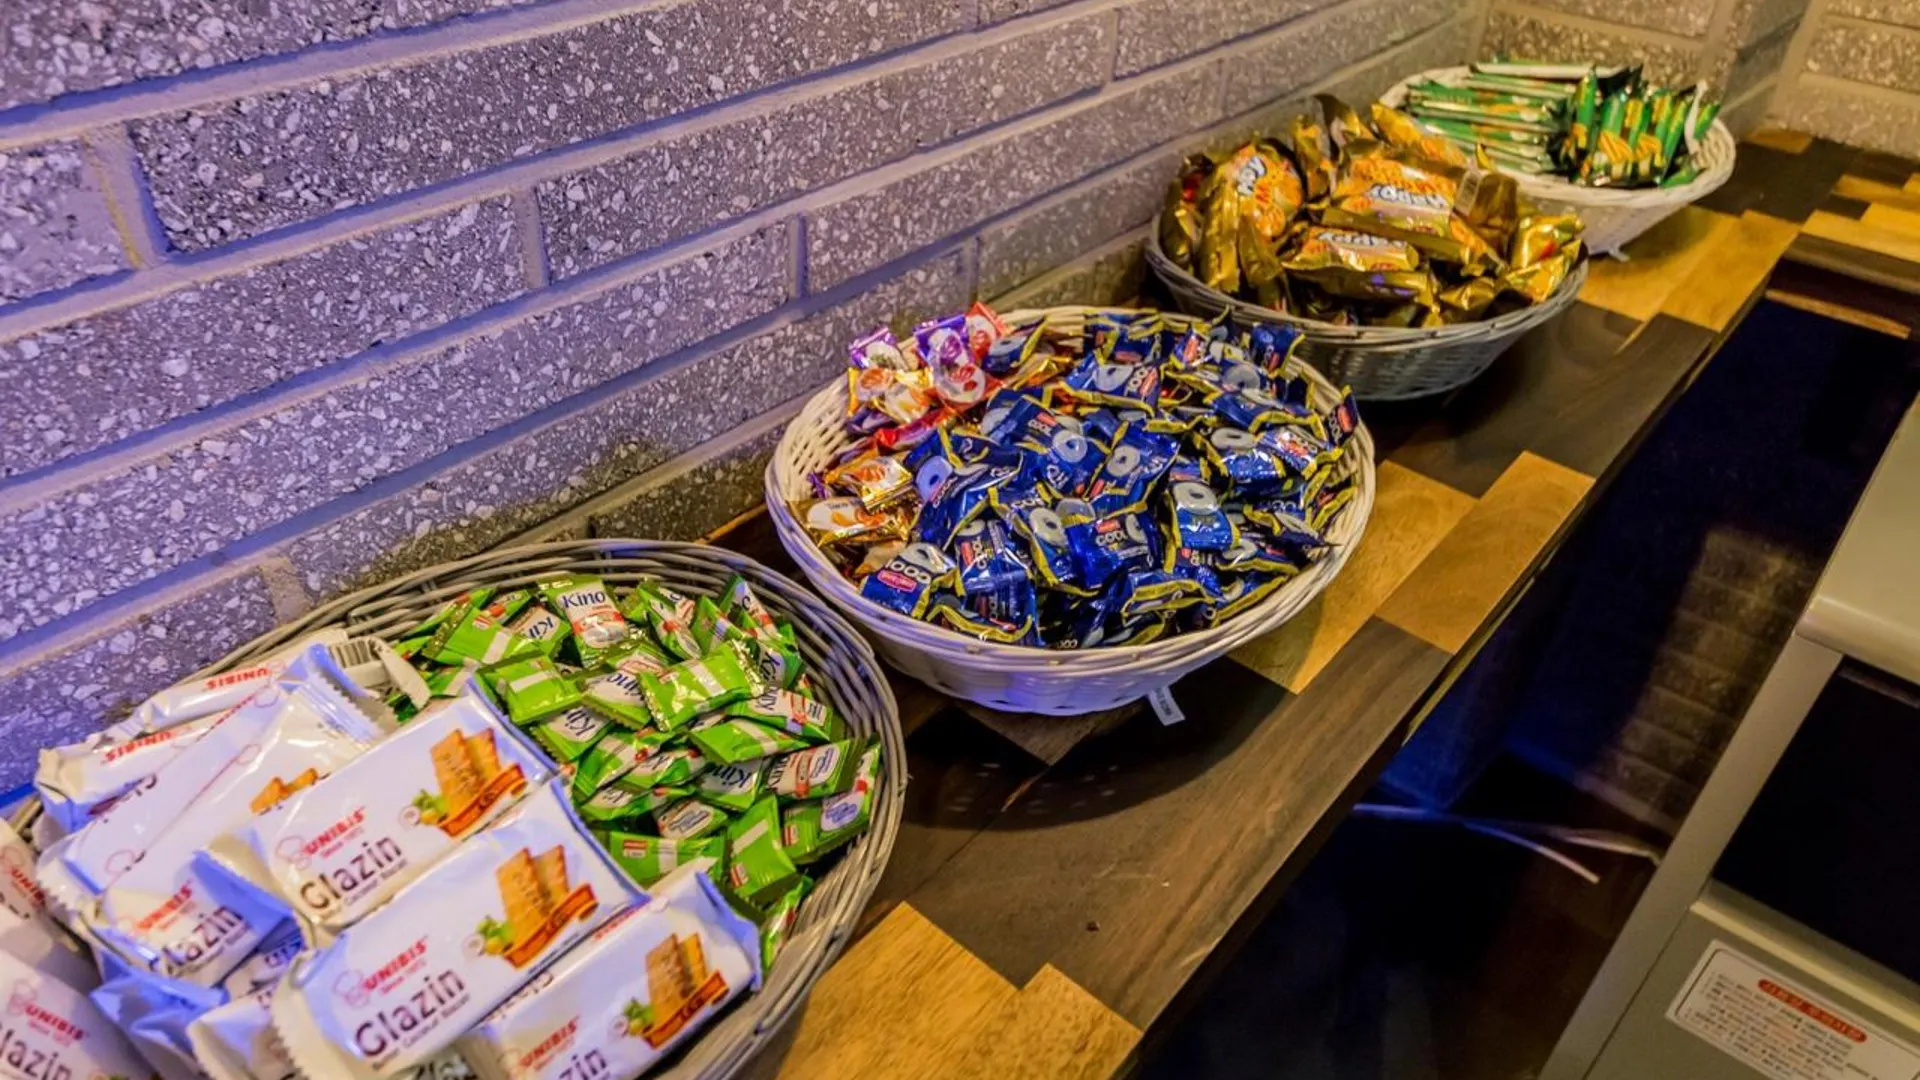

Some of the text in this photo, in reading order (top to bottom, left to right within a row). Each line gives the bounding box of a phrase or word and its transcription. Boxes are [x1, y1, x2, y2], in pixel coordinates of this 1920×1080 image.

[562, 589, 607, 609] Kino
[526, 616, 555, 640] Kin
[205, 667, 268, 690] UNIBIS
[760, 652, 782, 681] Ki
[564, 708, 597, 738] Kin
[104, 730, 173, 762] UNIBIS
[303, 808, 364, 855] UNIBIS
[301, 836, 402, 910] Glazin
[150, 905, 244, 973] lazin
[361, 938, 427, 991] UNIBIS
[24, 1002, 85, 1041] UNIBIS
[355, 968, 466, 1058] Glazin
[0, 1026, 72, 1080] lazin
[519, 1017, 577, 1068] UNIBIS
[558, 1048, 608, 1080] zin
